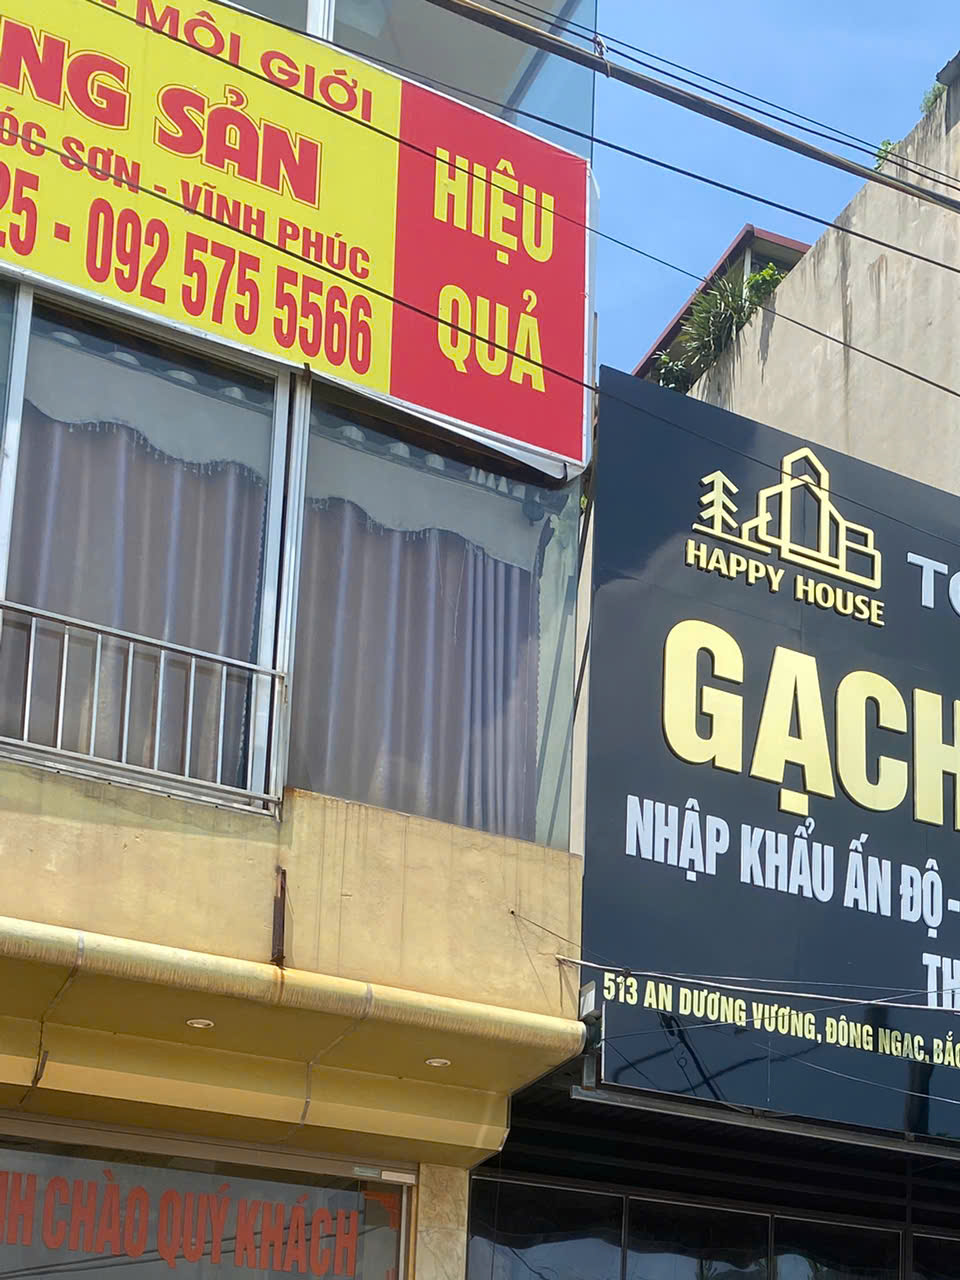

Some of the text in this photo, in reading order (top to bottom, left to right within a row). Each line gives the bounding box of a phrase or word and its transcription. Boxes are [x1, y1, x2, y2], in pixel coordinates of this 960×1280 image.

[136, 0, 240, 68] MÔI
[260, 51, 373, 122] GIỚI
[154, 83, 322, 209] SẢN
[432, 146, 555, 265] HIỆU
[60, 136, 140, 194] SƠN
[180, 178, 265, 234] VĨNH
[277, 218, 371, 280] PHÚC
[86, 197, 169, 305] 092
[181, 231, 261, 336] 575
[273, 265, 373, 375] 5566
[437, 284, 546, 392] QUẢ
[685, 538, 885, 627] HAPPY HOUSE
[625, 794, 730, 882] NHẬP
[740, 817, 834, 903] KHẨU
[843, 833, 892, 917] ẤN
[603, 971, 638, 1006] 513
[643, 980, 673, 1012] AN
[678, 987, 747, 1027] DƯƠNG
[751, 1001, 822, 1044] VƯƠNG,
[825, 1014, 873, 1051] ĐÔNG
[42, 1167, 150, 1259] CHÀO
[157, 1182, 230, 1269] QUÝ
[235, 1194, 358, 1277] KHÁCH
